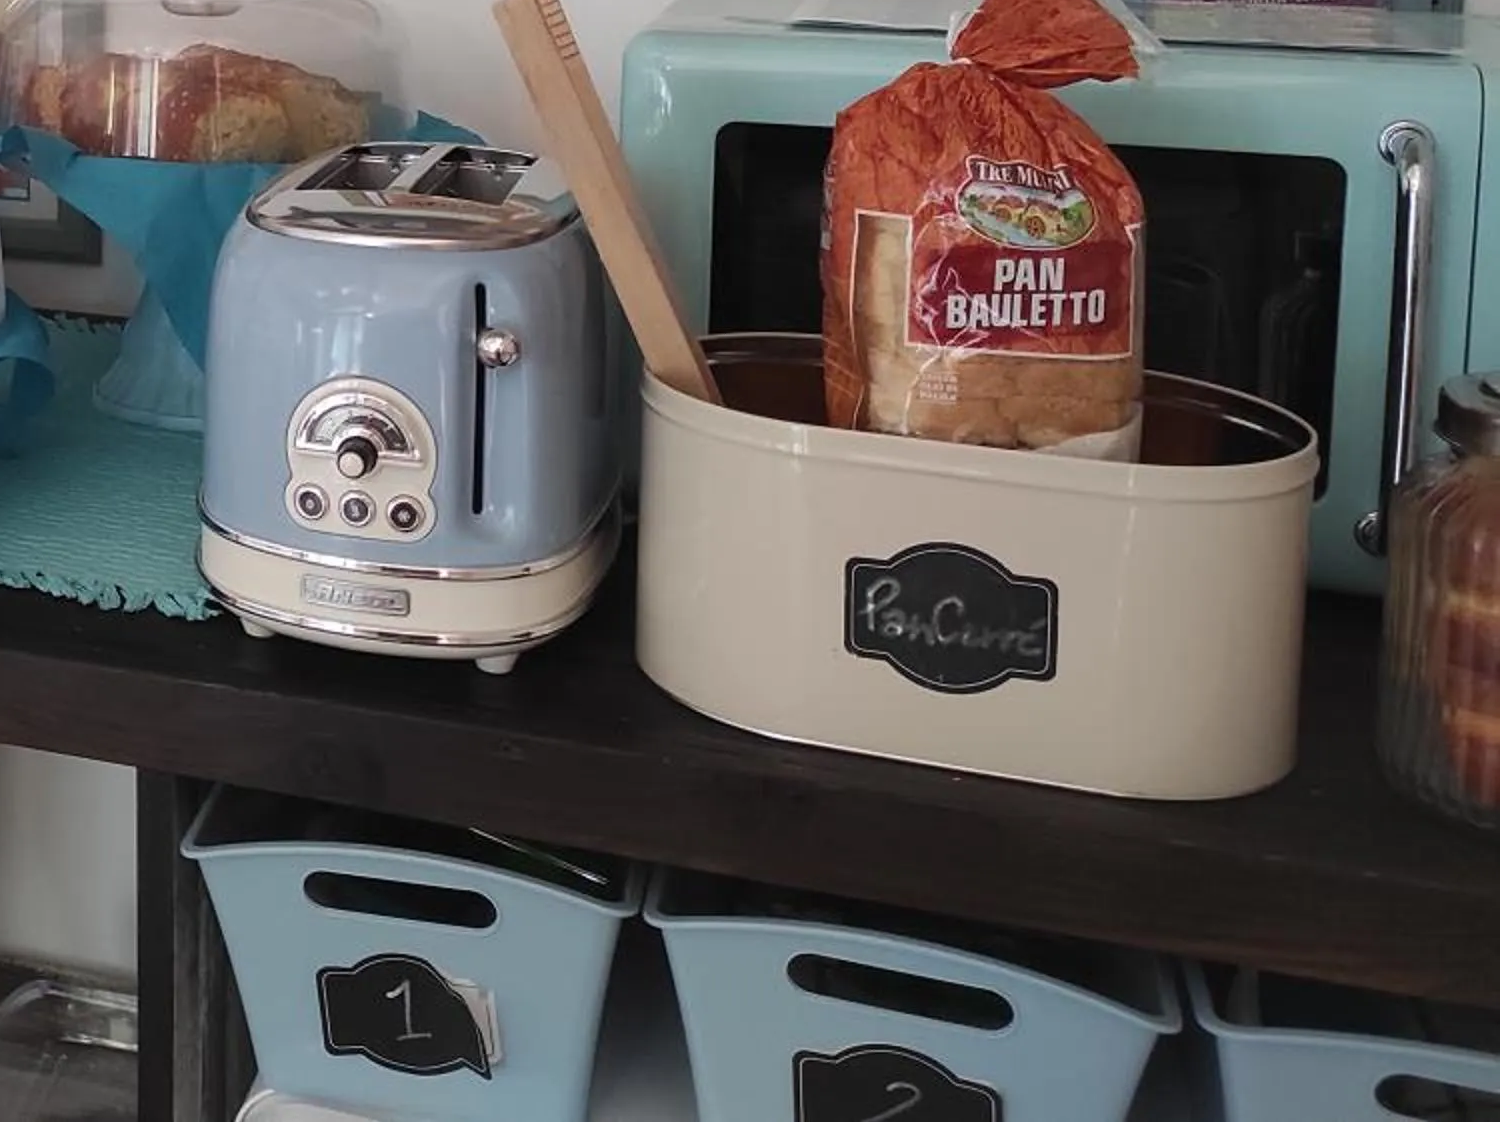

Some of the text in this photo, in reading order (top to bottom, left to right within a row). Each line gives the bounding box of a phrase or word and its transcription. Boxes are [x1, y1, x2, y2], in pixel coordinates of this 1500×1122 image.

[976, 161, 1013, 183] TRE
[994, 257, 1065, 291] PAN
[946, 288, 1106, 329] BAULETTO
[385, 979, 433, 1041] 1
